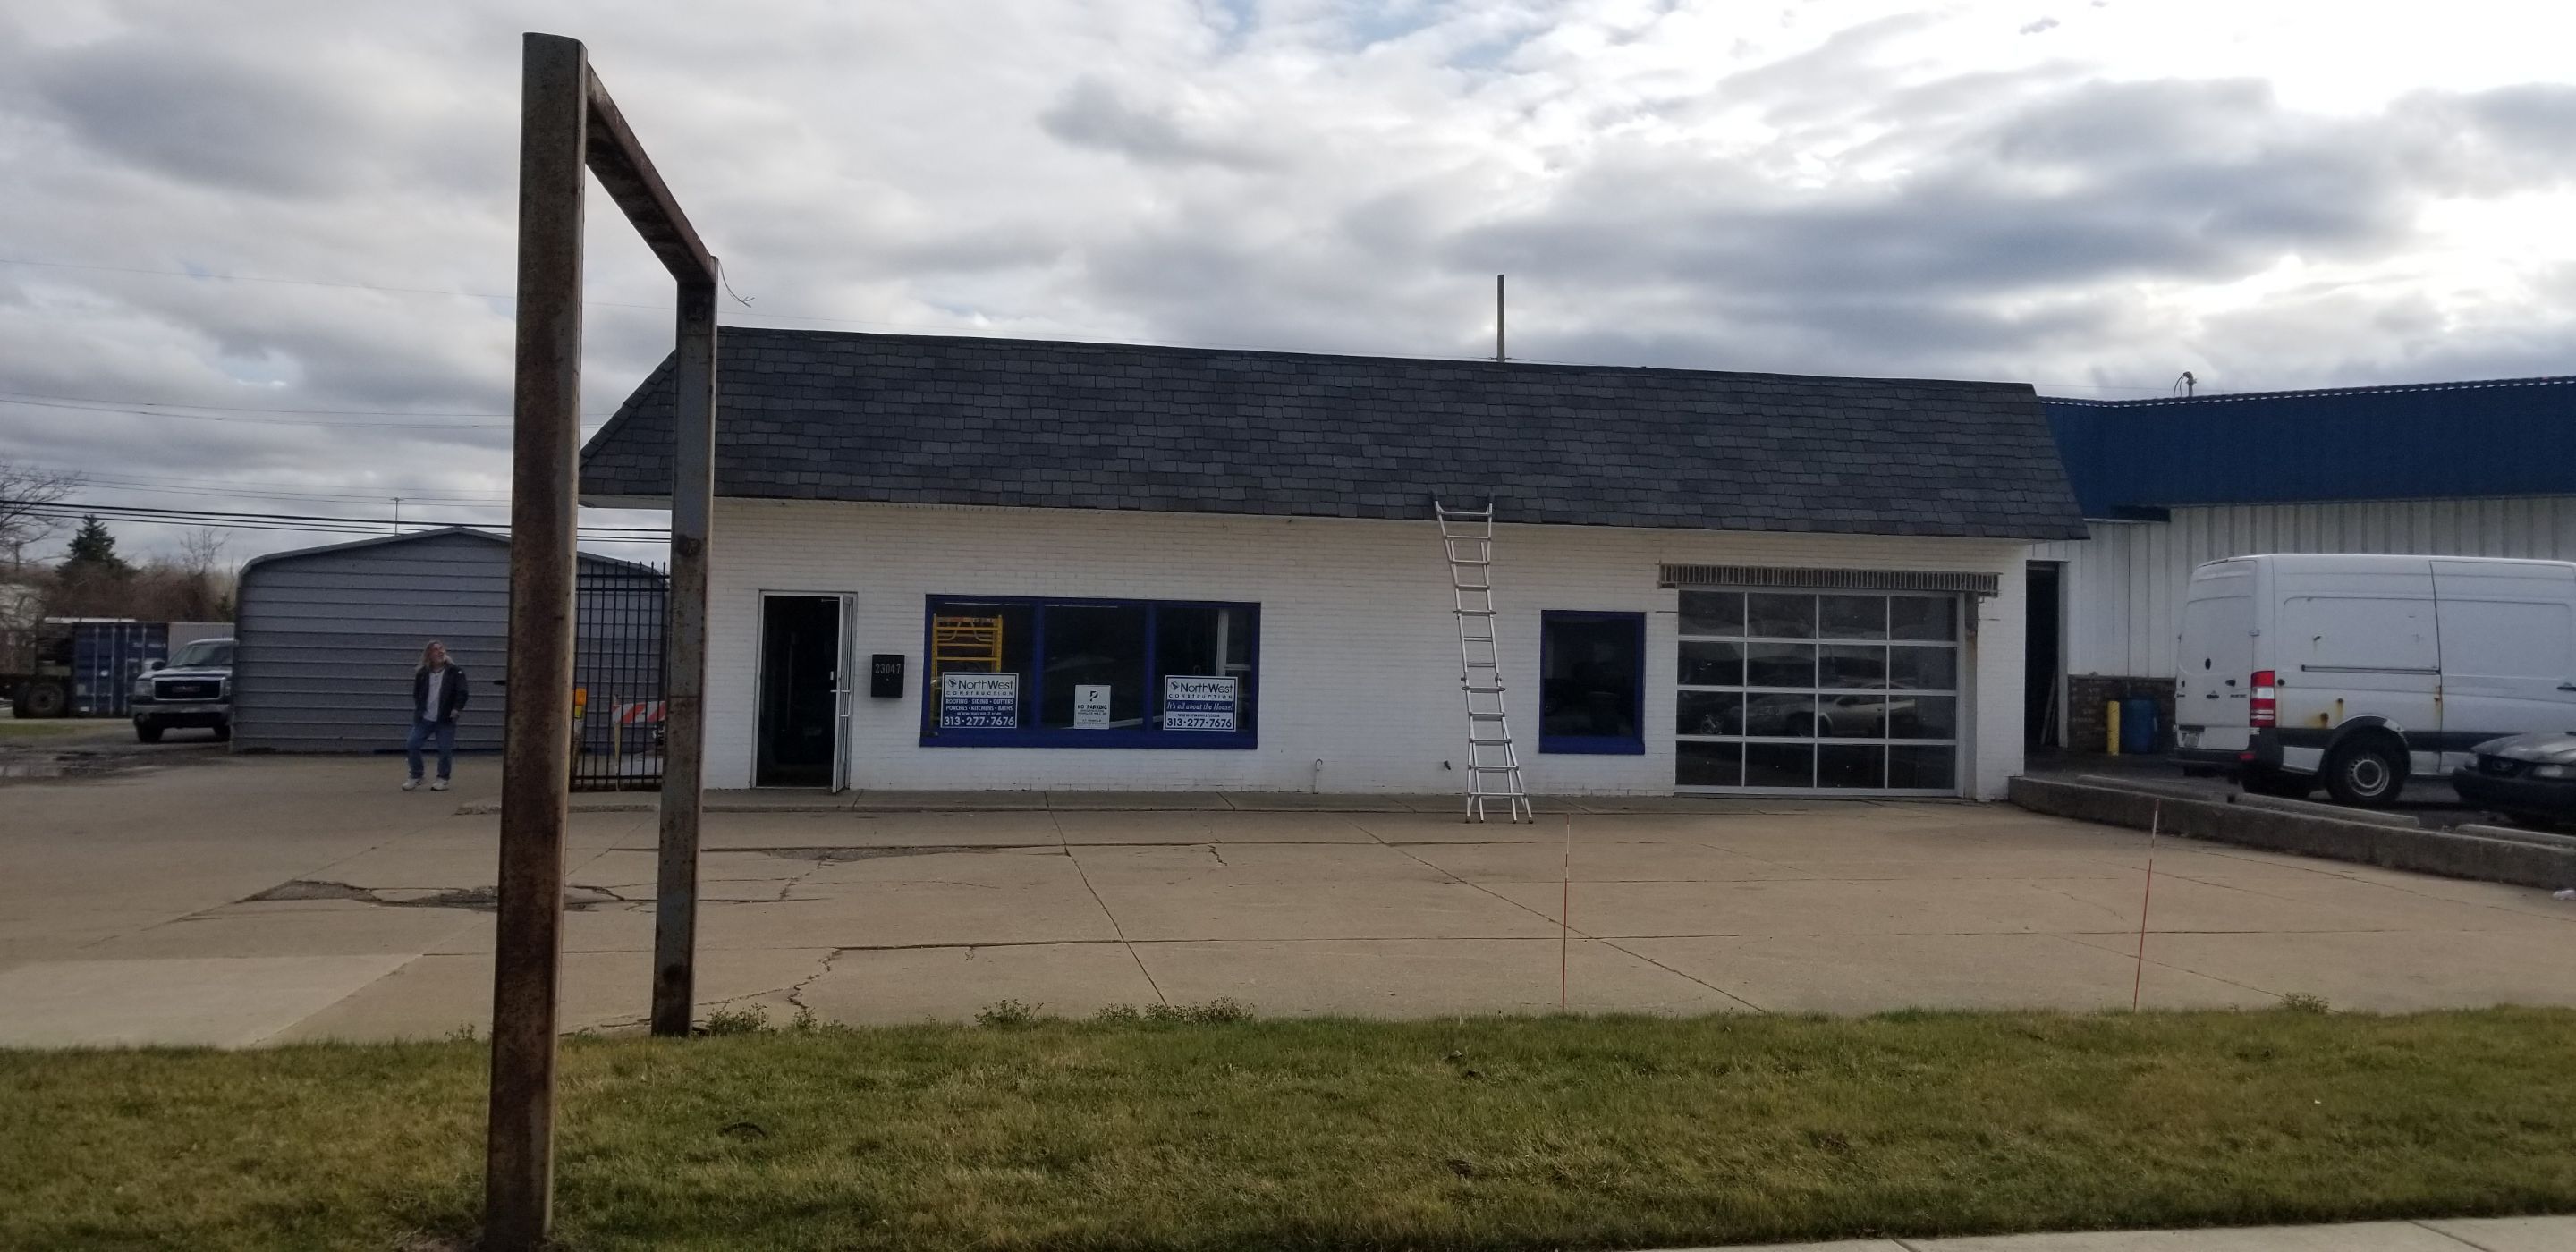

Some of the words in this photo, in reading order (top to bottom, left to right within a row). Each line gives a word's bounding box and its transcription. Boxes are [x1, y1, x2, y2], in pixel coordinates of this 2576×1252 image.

[875, 663, 901, 674] 23047
[958, 680, 1013, 689] NorthWest
[1181, 682, 1233, 693] NorthWest
